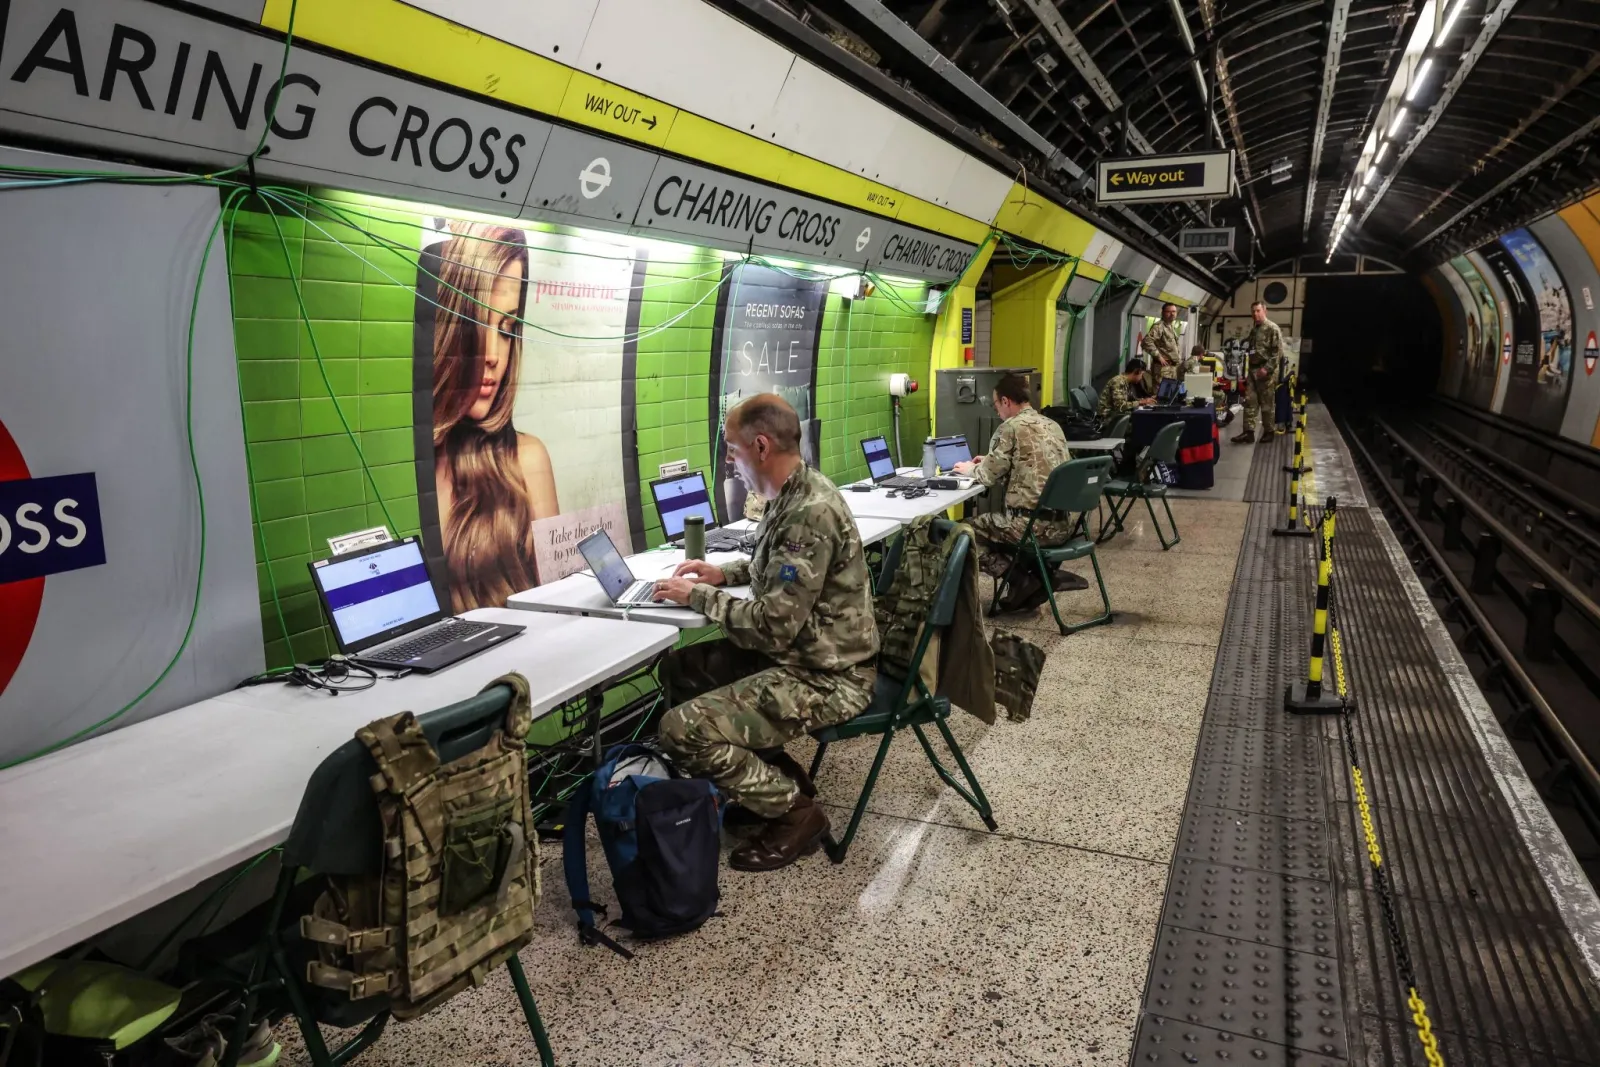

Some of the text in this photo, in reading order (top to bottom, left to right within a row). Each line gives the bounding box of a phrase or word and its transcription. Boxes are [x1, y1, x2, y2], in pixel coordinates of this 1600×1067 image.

[0, 0, 527, 184] ARING CROSS
[584, 92, 642, 127] WAY OUT
[1126, 169, 1185, 187] Way out
[653, 176, 841, 249] CHARING CROSS
[867, 192, 889, 206] WAY OUT
[883, 233, 971, 274] CHARING CROSS
[745, 302, 805, 319] REGENT SOFAS
[741, 340, 800, 377] SALE
[0, 497, 87, 556] SS
[549, 526, 572, 545] Take
[574, 522, 589, 540] the
[554, 549, 563, 562] to
